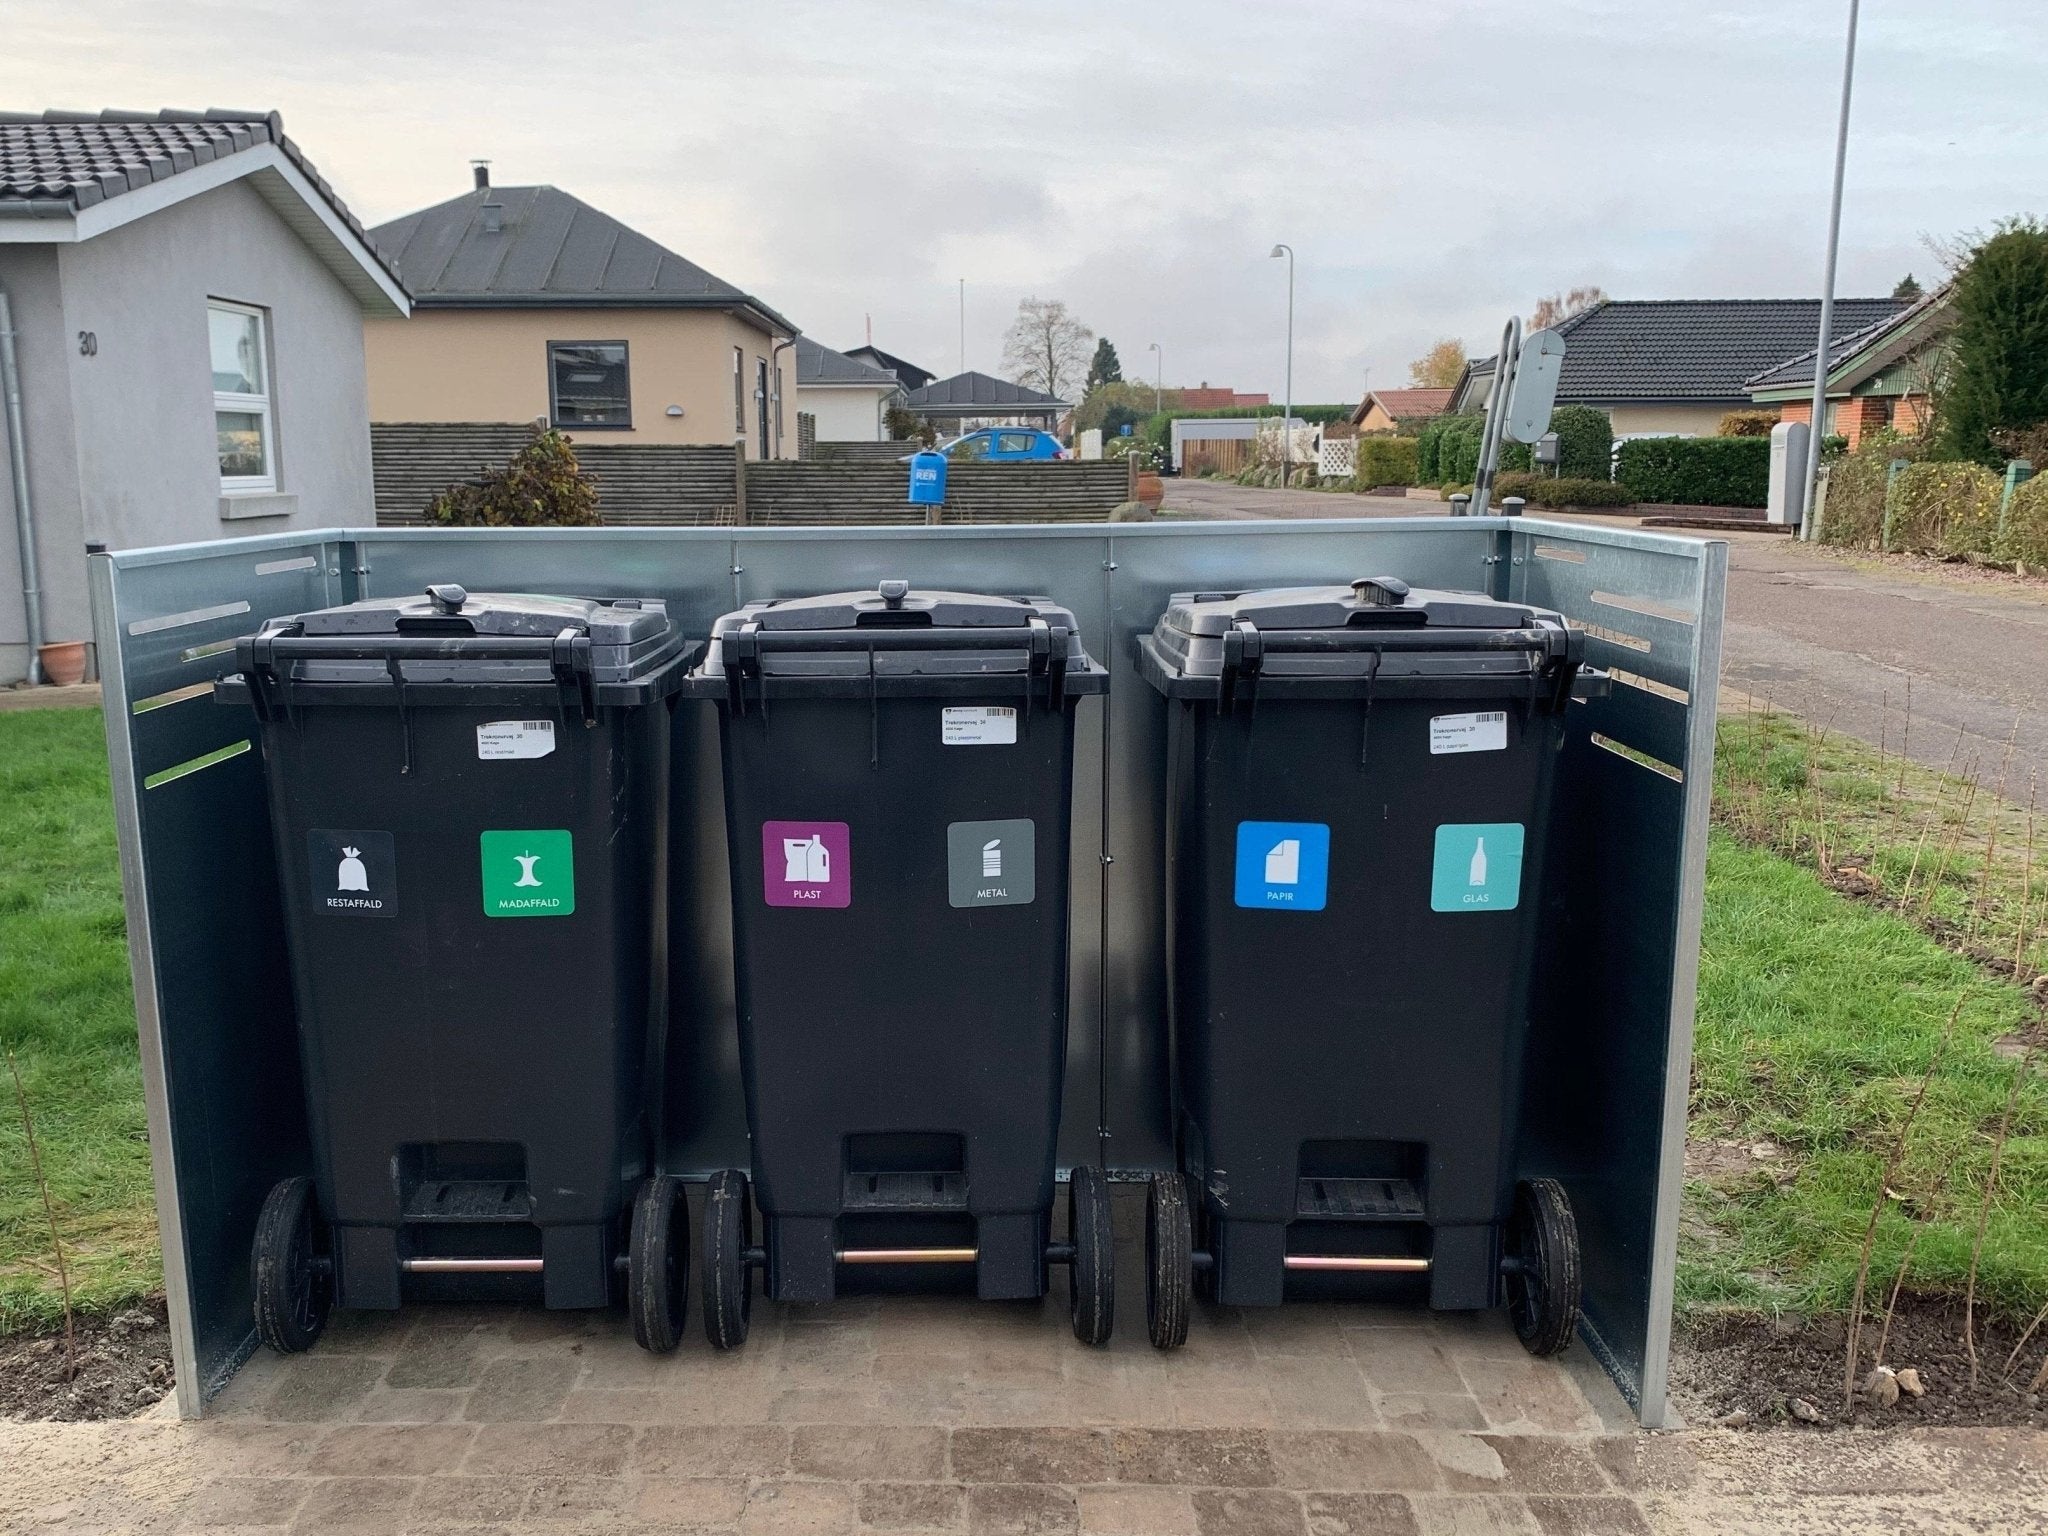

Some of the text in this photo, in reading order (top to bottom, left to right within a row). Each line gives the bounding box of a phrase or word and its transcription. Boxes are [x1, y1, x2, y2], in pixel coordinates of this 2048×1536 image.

[78, 330, 98, 357] 30
[915, 470, 937, 481] REN
[793, 889, 821, 900] PLAST
[977, 887, 1008, 899] METAL
[1266, 891, 1294, 902] PAPIR
[1462, 893, 1489, 904] GLAS
[327, 898, 383, 910] RESTAFFALD
[499, 898, 560, 909] MADAFFALD
